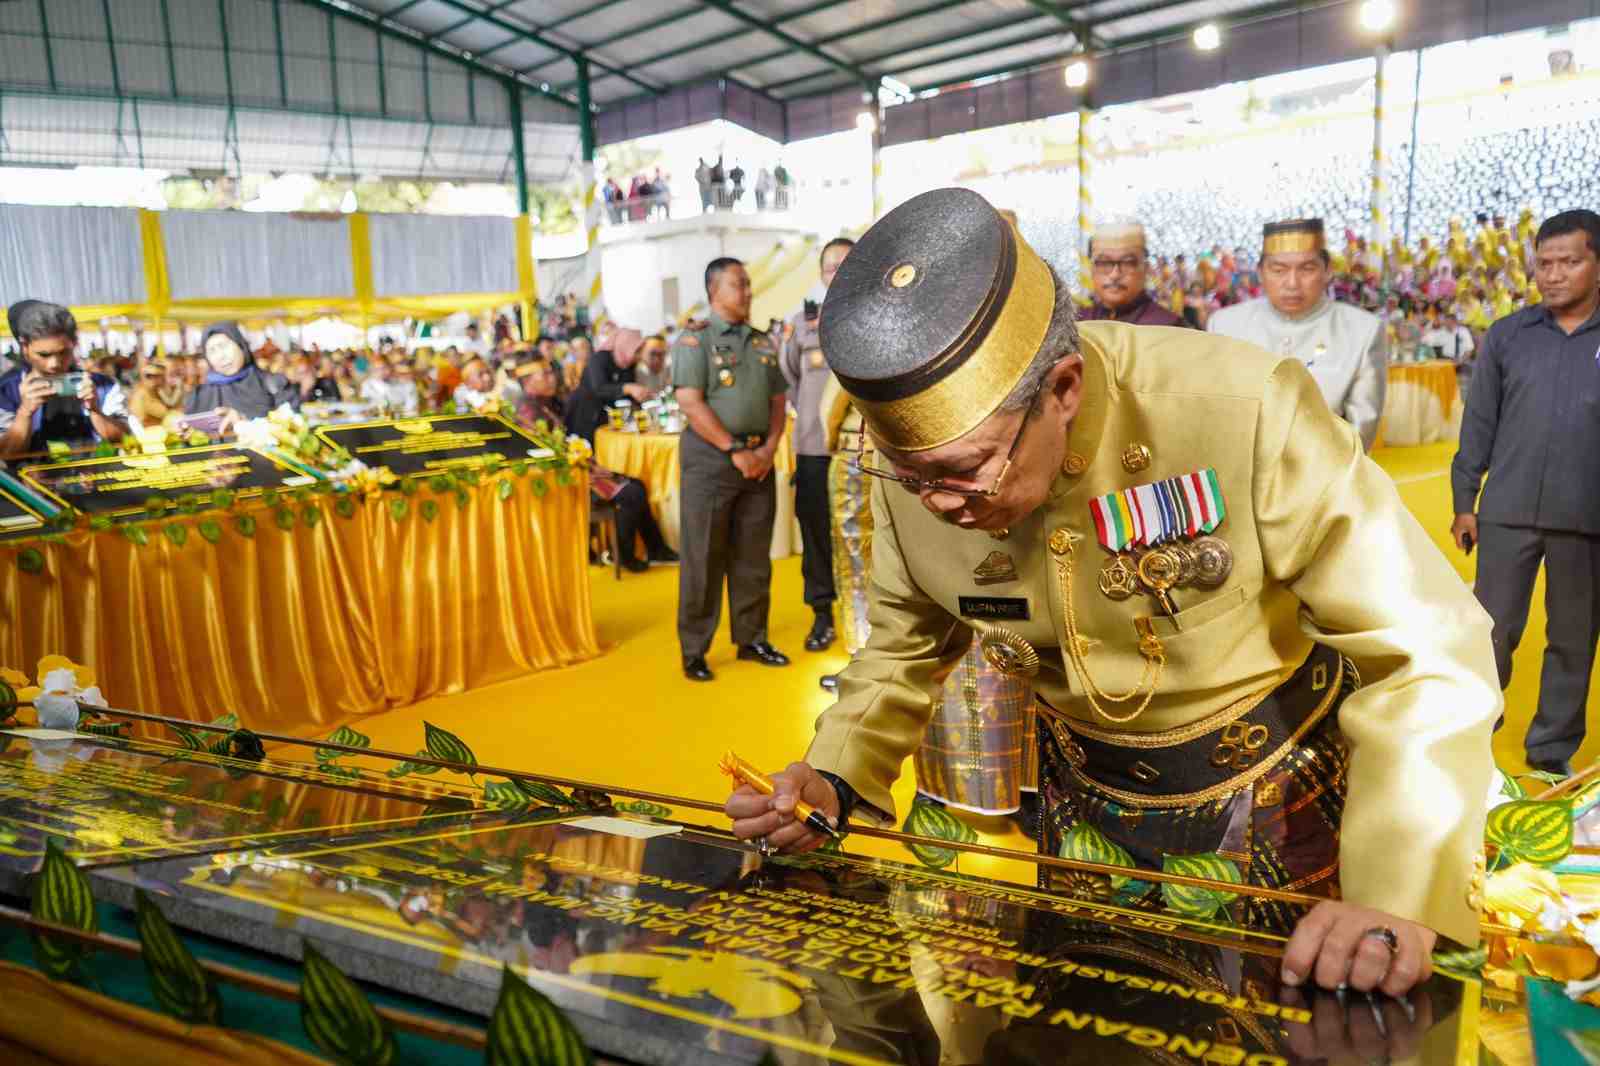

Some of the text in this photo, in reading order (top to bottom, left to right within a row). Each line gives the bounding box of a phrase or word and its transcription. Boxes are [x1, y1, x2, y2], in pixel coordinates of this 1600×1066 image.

[702, 890, 814, 916] JALAN
[926, 880, 1045, 906] TAUFAN
[587, 894, 802, 942] PAREPARE
[690, 901, 971, 965] MERESMIKAN
[1120, 916, 1178, 932] DR.
[399, 864, 1292, 1066] DENGAN RAHMAT TUHAN YANG MAHA ESA
[792, 936, 921, 970] KOTA
